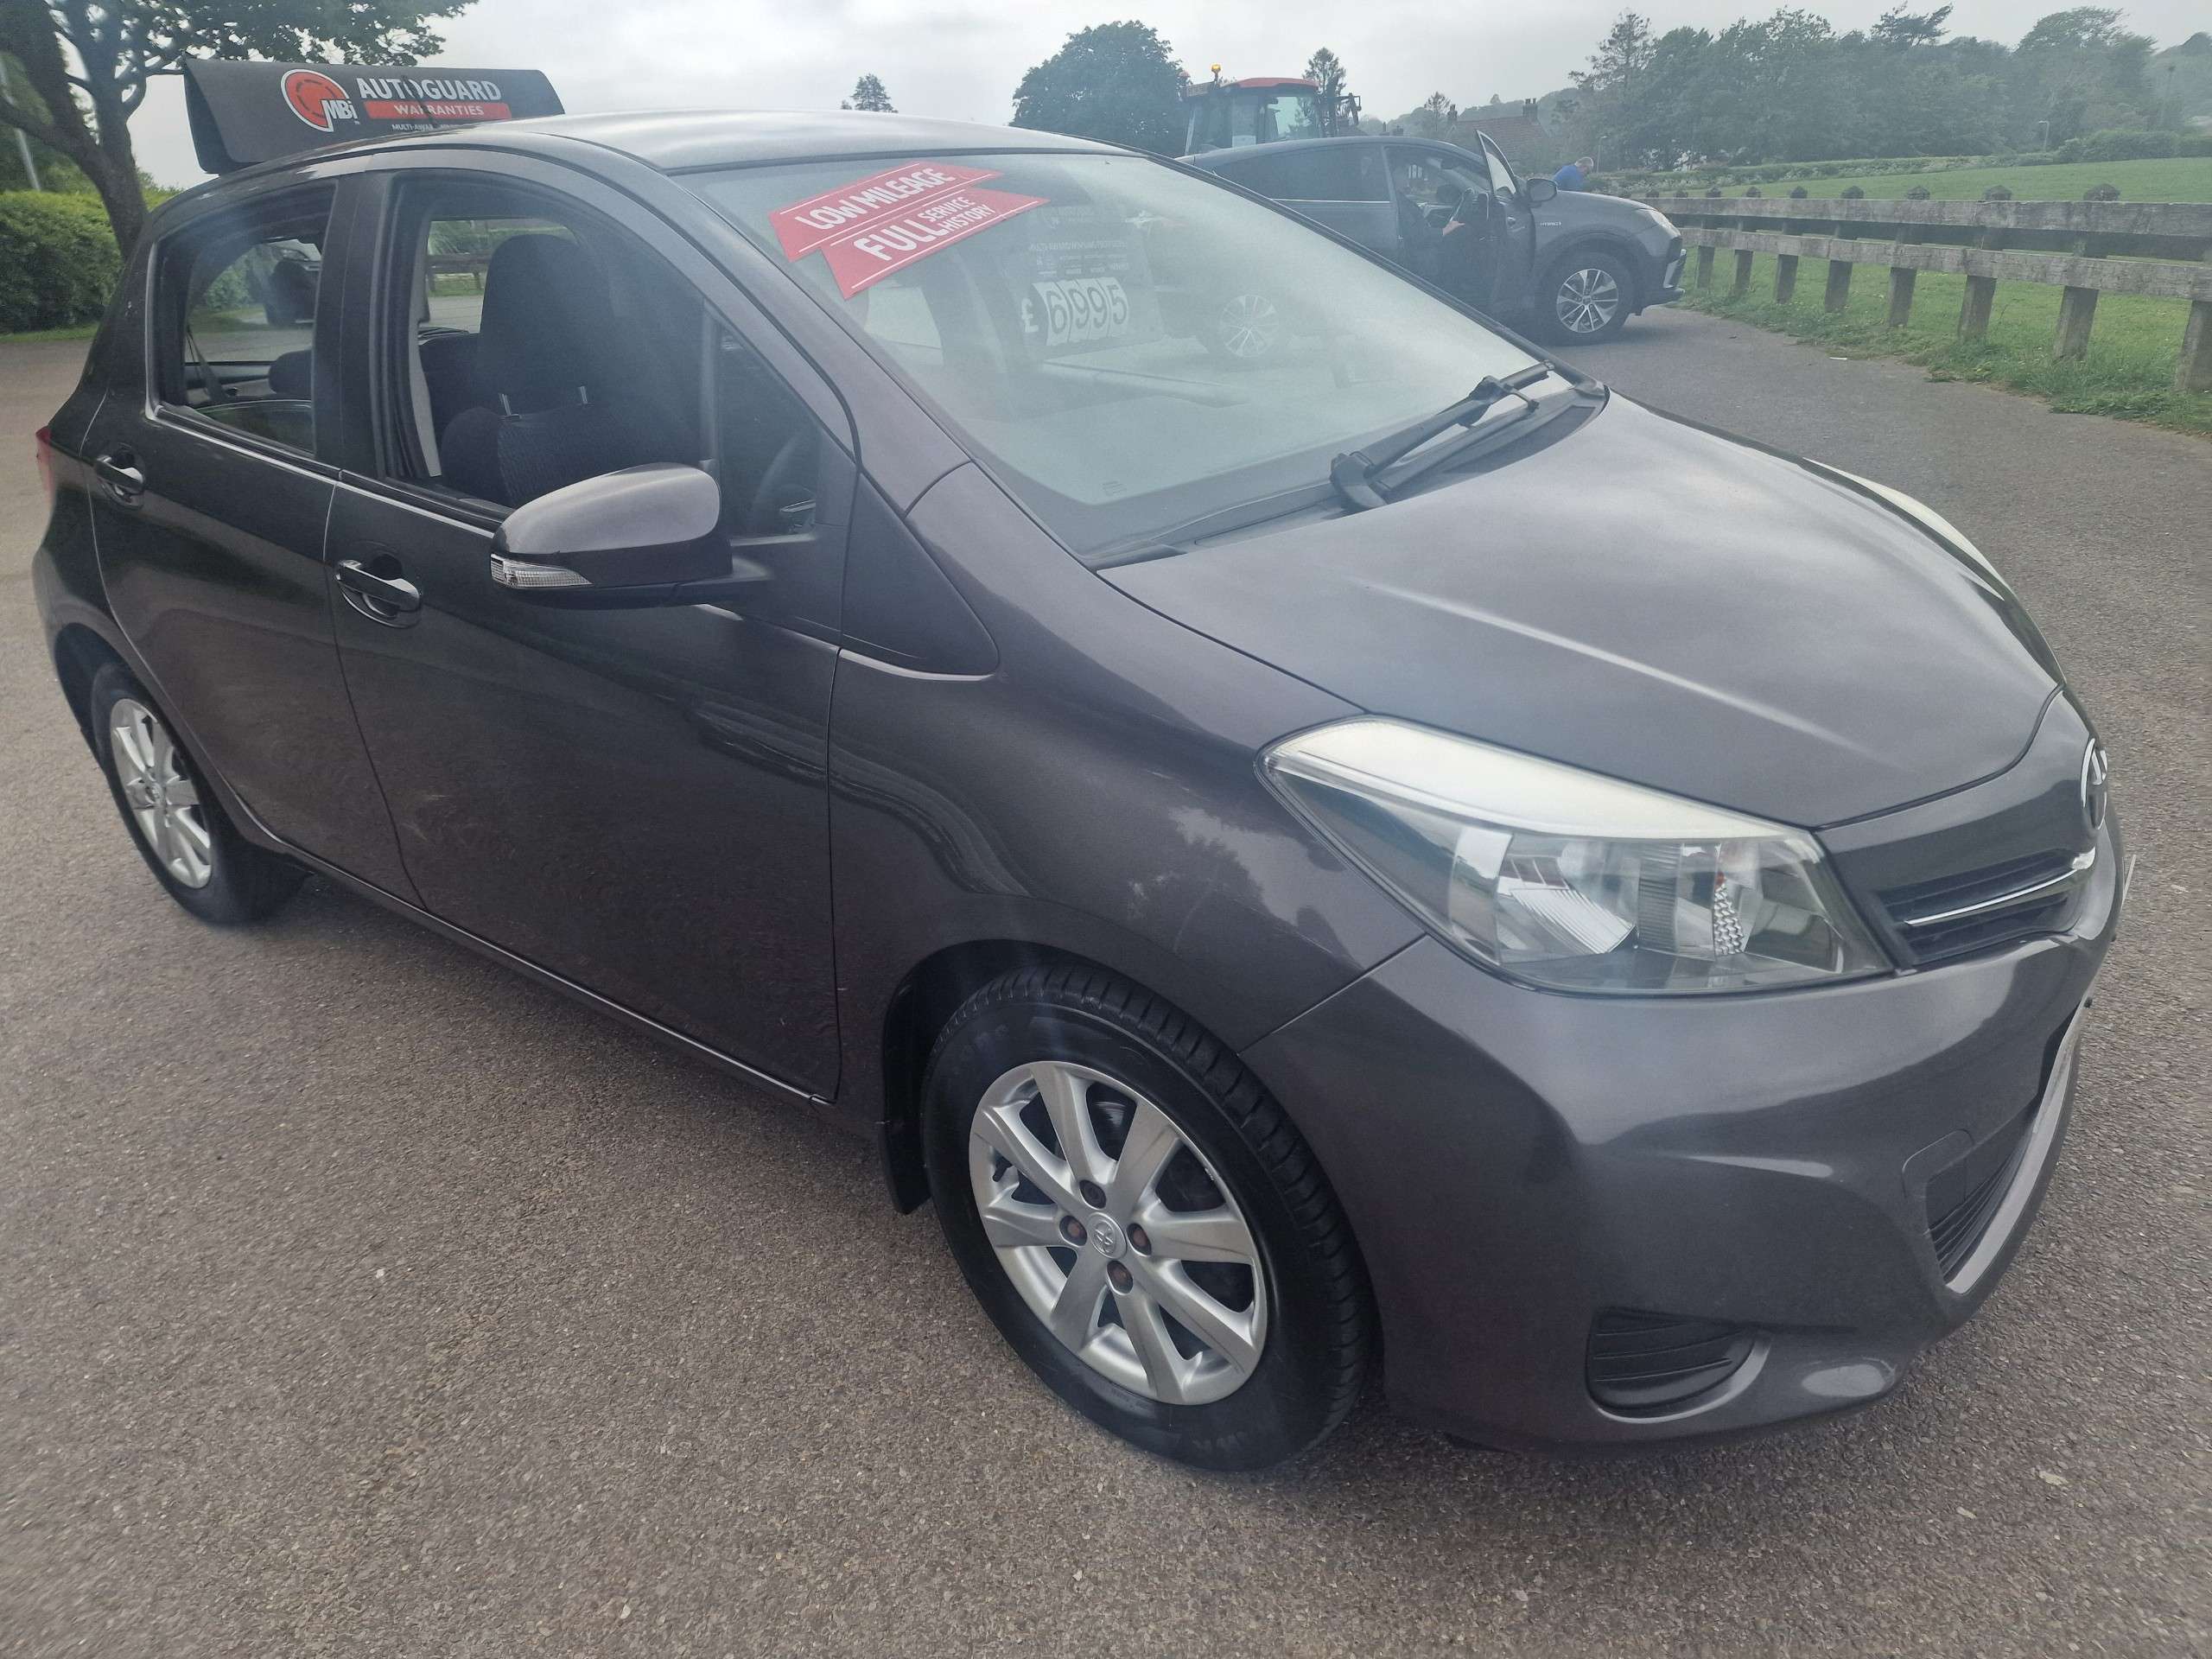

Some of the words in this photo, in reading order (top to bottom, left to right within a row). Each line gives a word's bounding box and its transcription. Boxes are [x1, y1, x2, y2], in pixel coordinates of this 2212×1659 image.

[795, 200, 868, 229] LOW
[849, 168, 957, 209] MILEAGE
[918, 196, 976, 222] SERVICE
[937, 204, 996, 232] HISTORY
[854, 219, 950, 261] FULL
